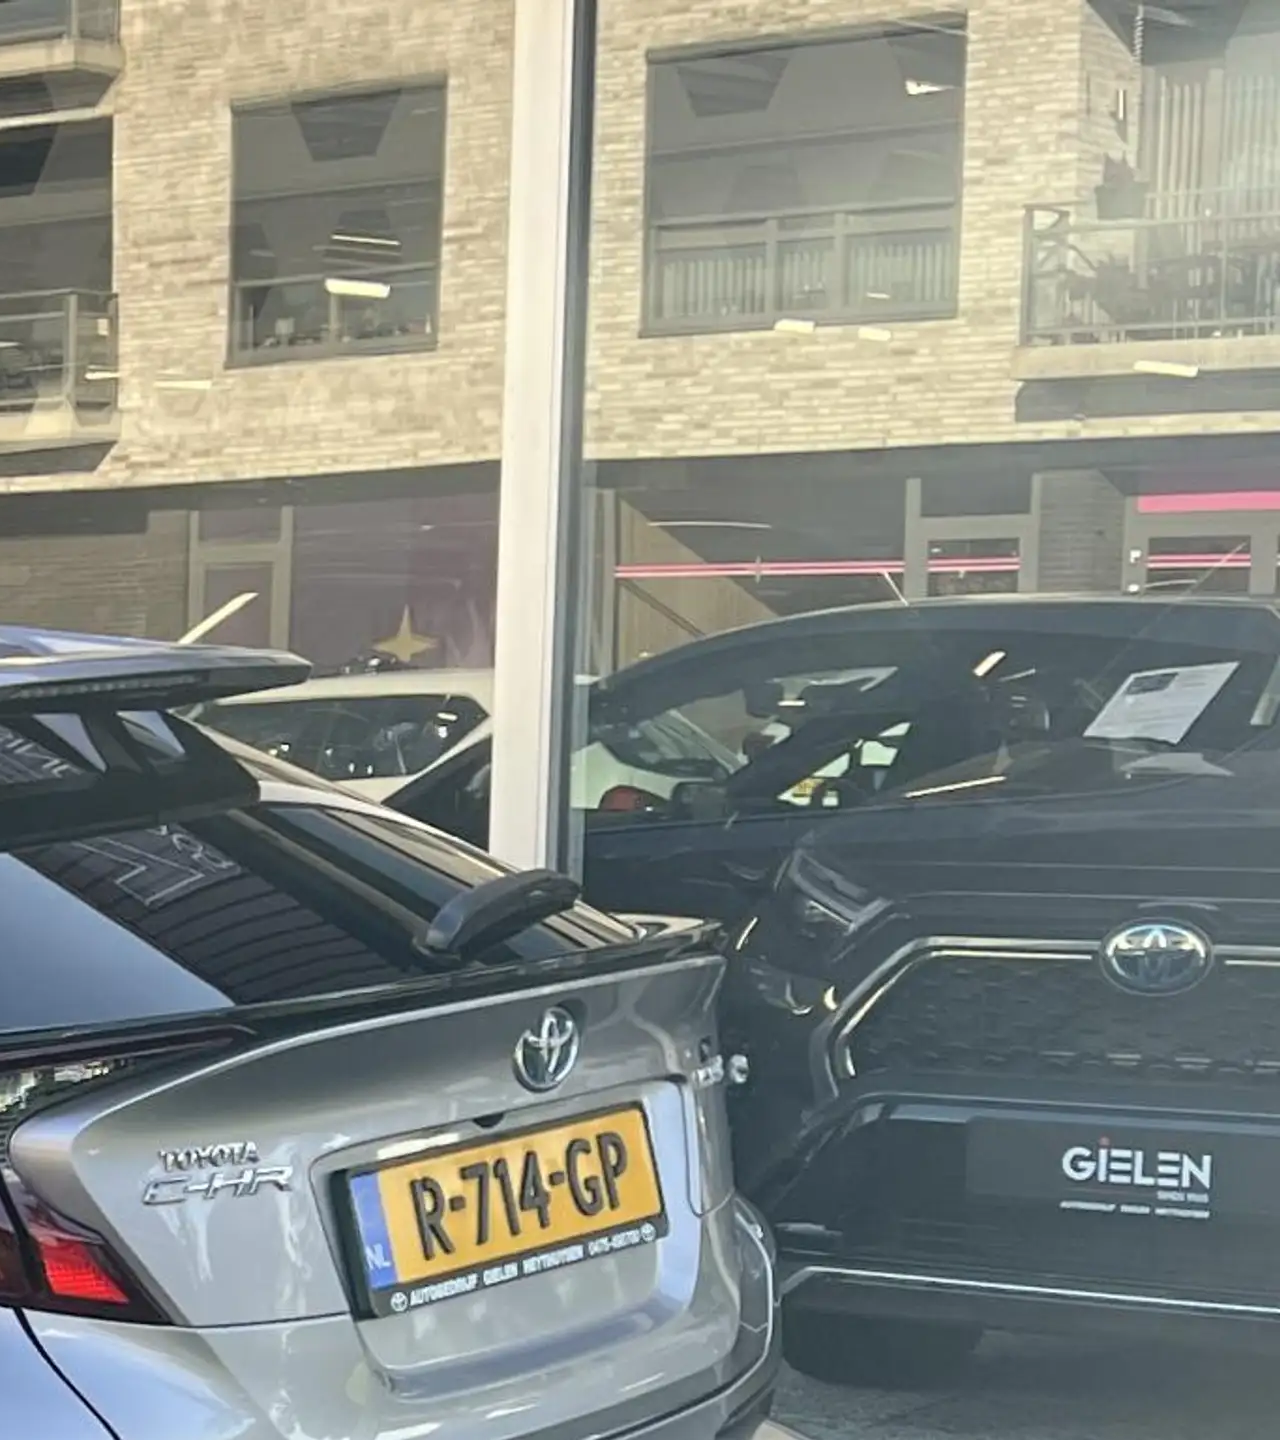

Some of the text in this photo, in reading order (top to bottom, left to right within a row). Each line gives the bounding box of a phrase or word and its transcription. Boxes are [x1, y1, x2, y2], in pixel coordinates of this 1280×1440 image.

[158, 1141, 260, 1173] TOYOTA
[1061, 1135, 1212, 1190] GIELEN
[142, 1165, 293, 1206] C-HR
[410, 1131, 628, 1261] R-714-GP
[365, 1243, 390, 1269] NL
